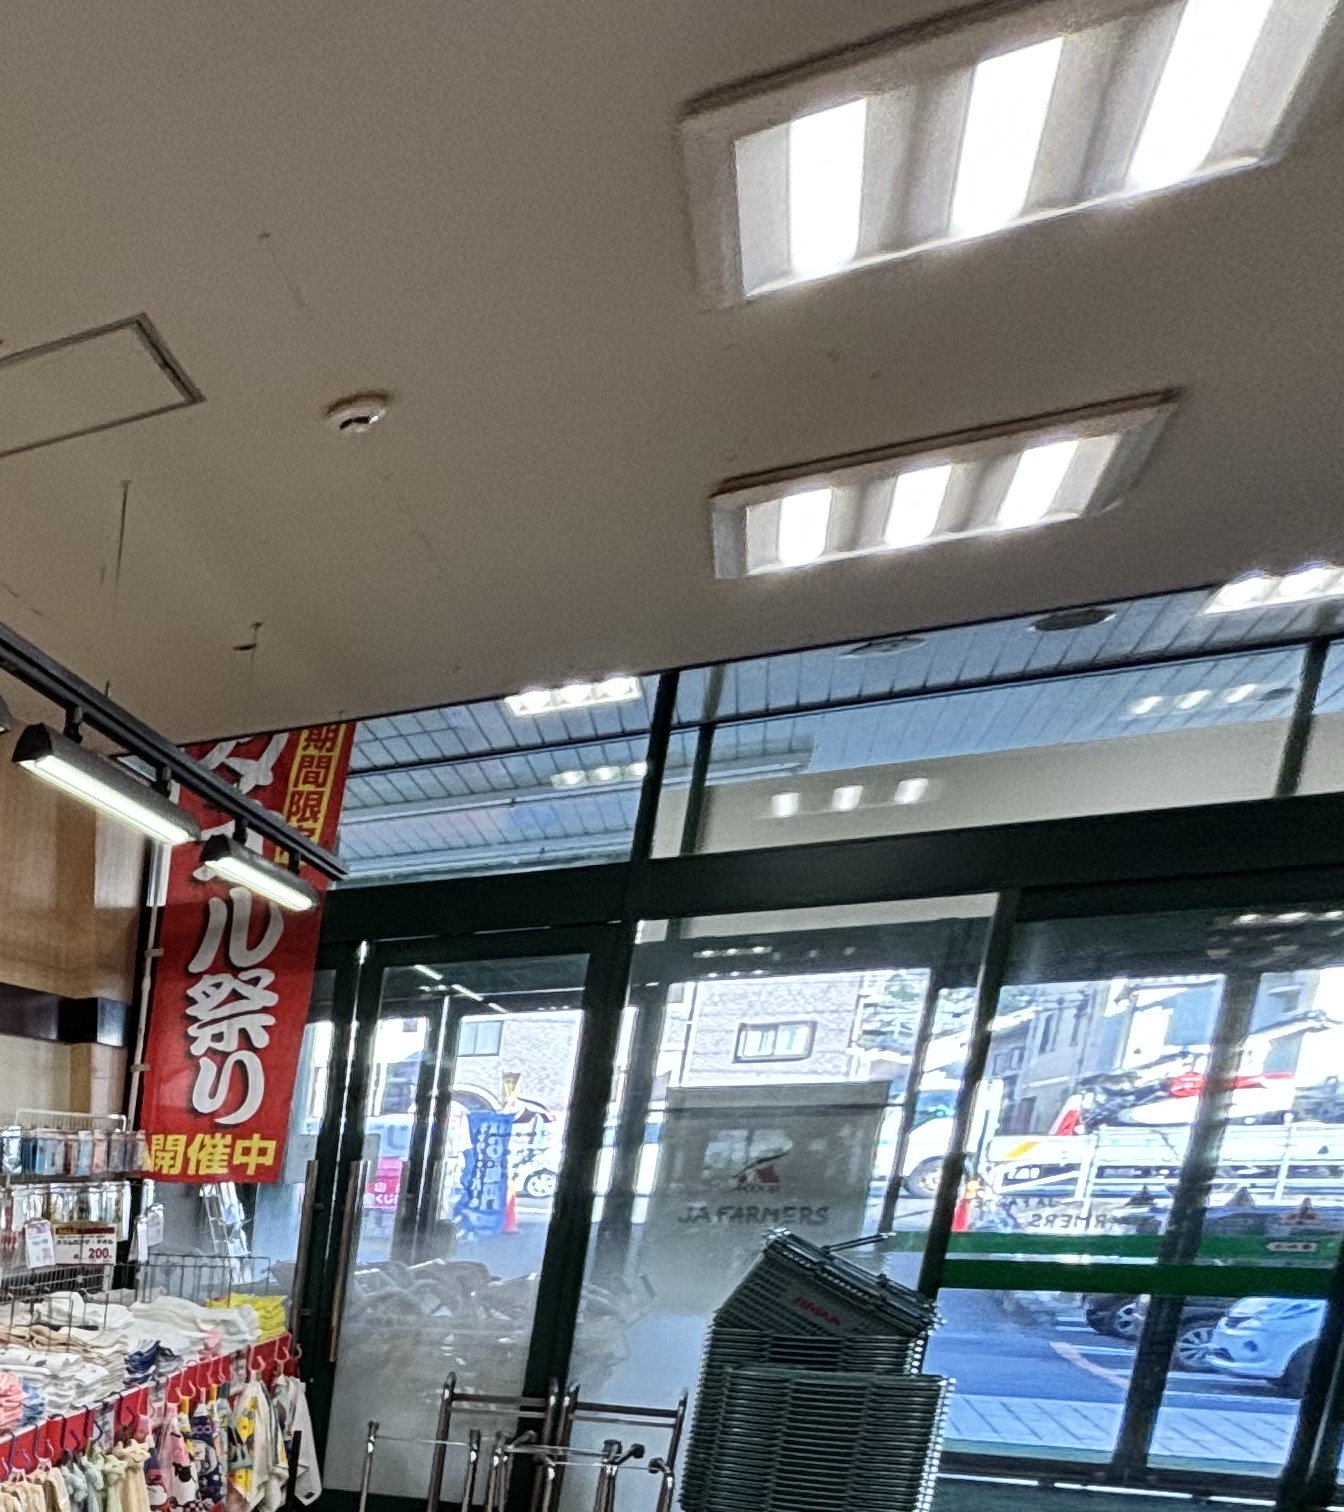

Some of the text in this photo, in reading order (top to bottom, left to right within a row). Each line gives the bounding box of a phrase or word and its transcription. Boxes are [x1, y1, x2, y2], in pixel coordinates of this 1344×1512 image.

[284, 724, 336, 848] 期間限
[150, 1132, 278, 1176] 開催中
[716, 1205, 831, 1226] FARMERS
[88, 1247, 109, 1259] 200
